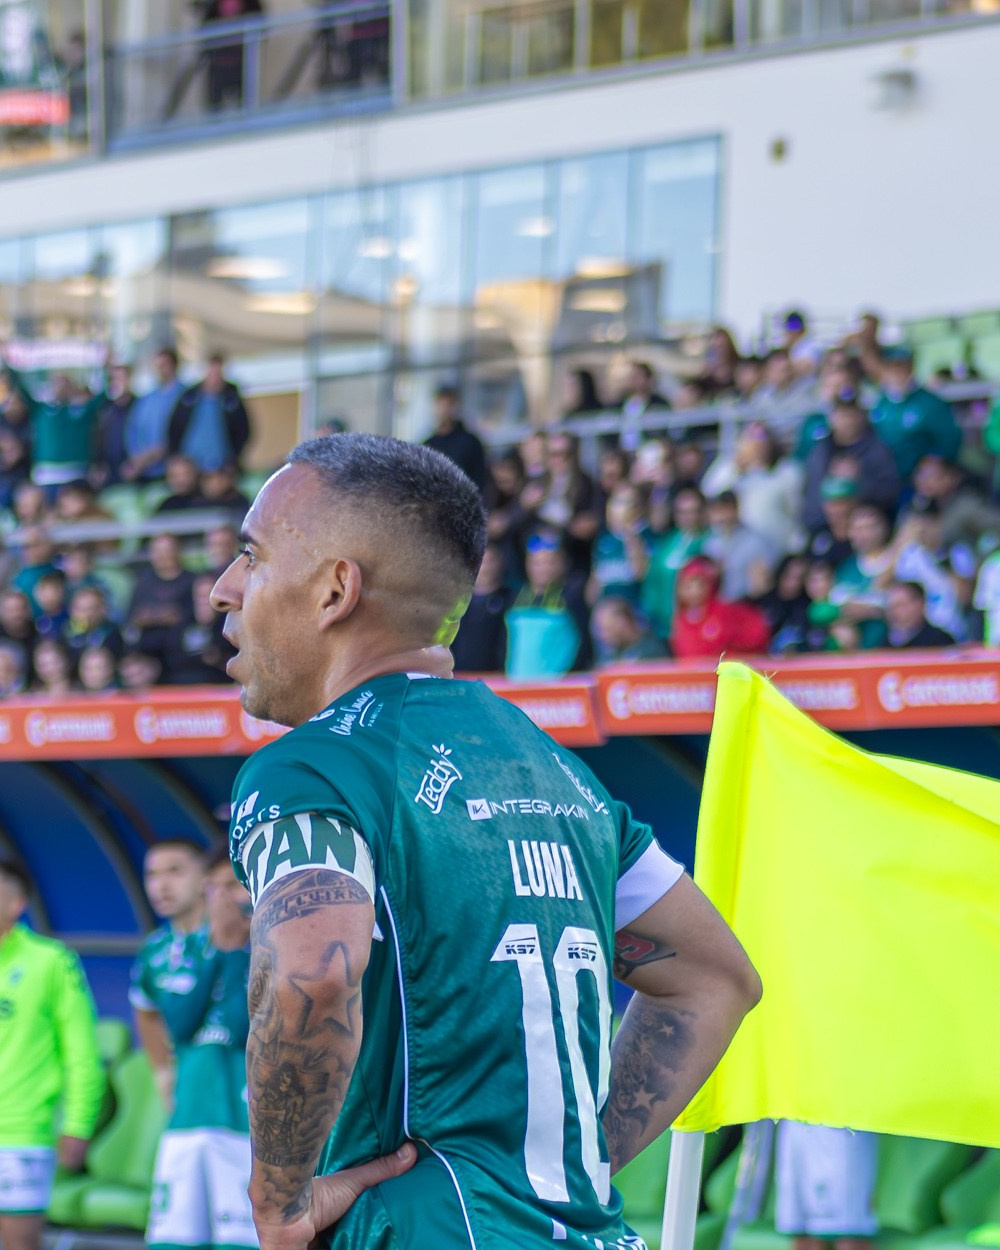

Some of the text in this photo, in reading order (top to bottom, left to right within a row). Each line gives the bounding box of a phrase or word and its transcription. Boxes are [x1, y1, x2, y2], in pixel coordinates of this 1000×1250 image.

[414, 755, 462, 810] Teddy
[490, 799, 589, 820] INTEGRAKIN
[508, 840, 584, 901] LUNA
[489, 923, 612, 1207] 10
